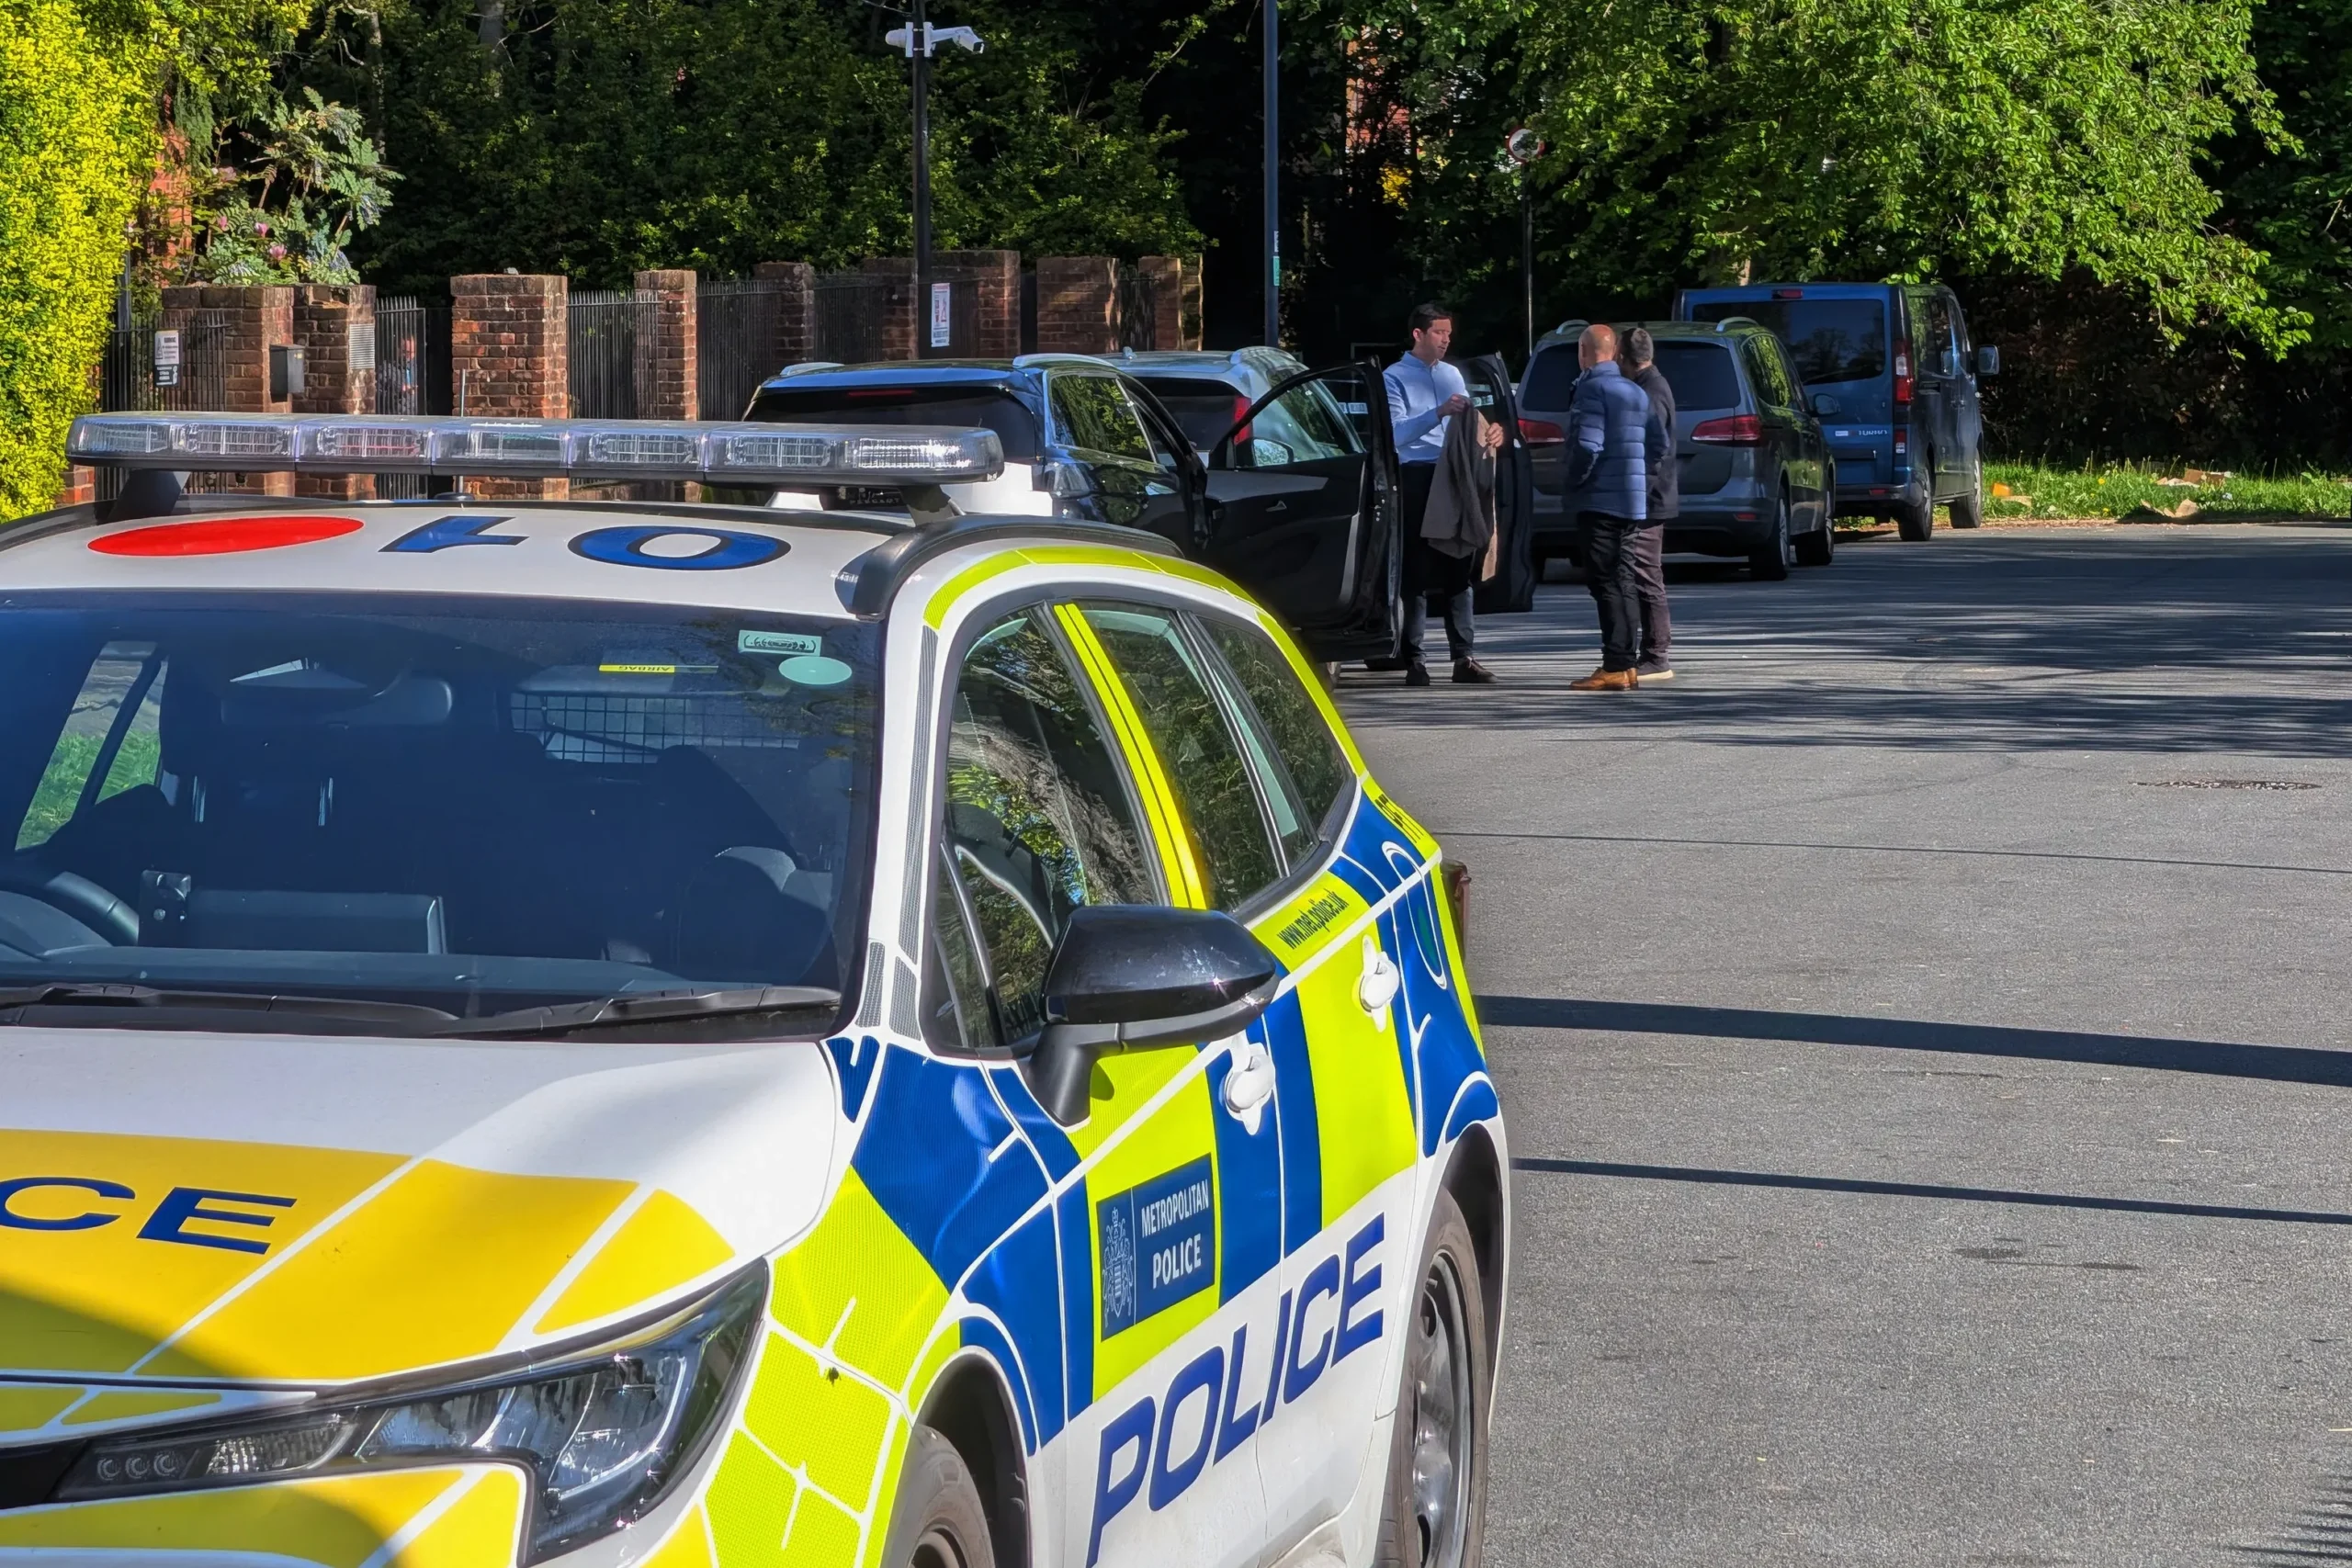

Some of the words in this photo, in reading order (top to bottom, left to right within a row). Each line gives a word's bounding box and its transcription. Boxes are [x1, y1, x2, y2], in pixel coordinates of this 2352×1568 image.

[1141, 1179, 1209, 1238] METROPOLITAN
[1152, 1233, 1202, 1290] POLICE
[1086, 1212, 1384, 1568] POLICE
